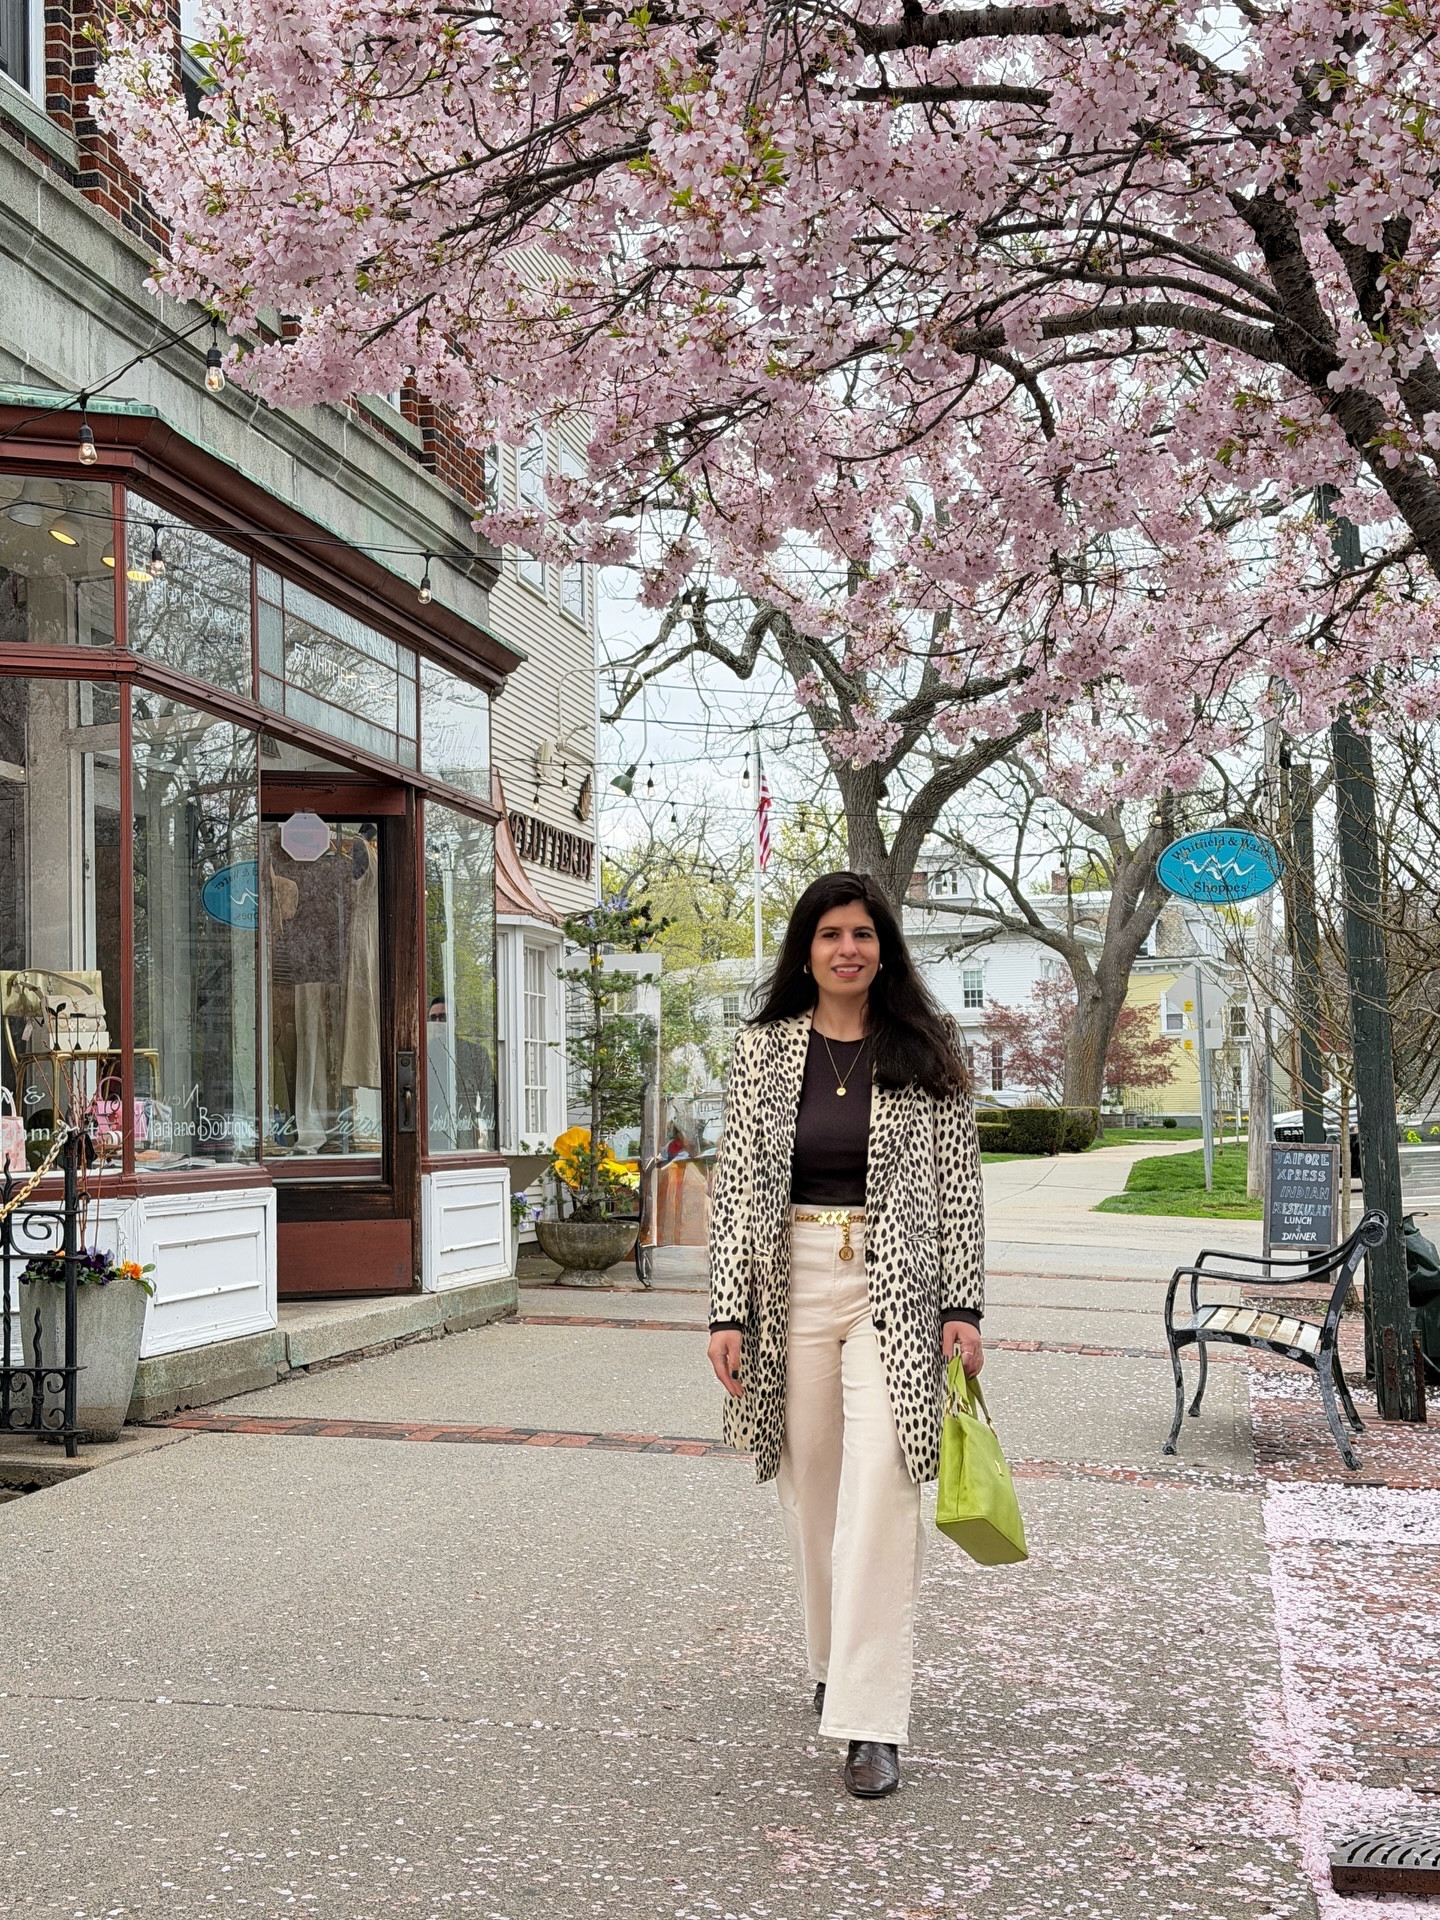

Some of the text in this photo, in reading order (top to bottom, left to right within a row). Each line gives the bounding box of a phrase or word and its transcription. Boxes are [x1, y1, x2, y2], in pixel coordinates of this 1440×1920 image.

[1228, 837, 1239, 847] &
[1194, 881, 1247, 894] Shoppes
[1275, 1152, 1330, 1166] JAIPORE
[1277, 1169, 1326, 1182] XPRESS
[1280, 1186, 1330, 1200] INDIAN
[1284, 1216, 1312, 1225] LUNCH
[1281, 1232, 1317, 1241] DINNER
